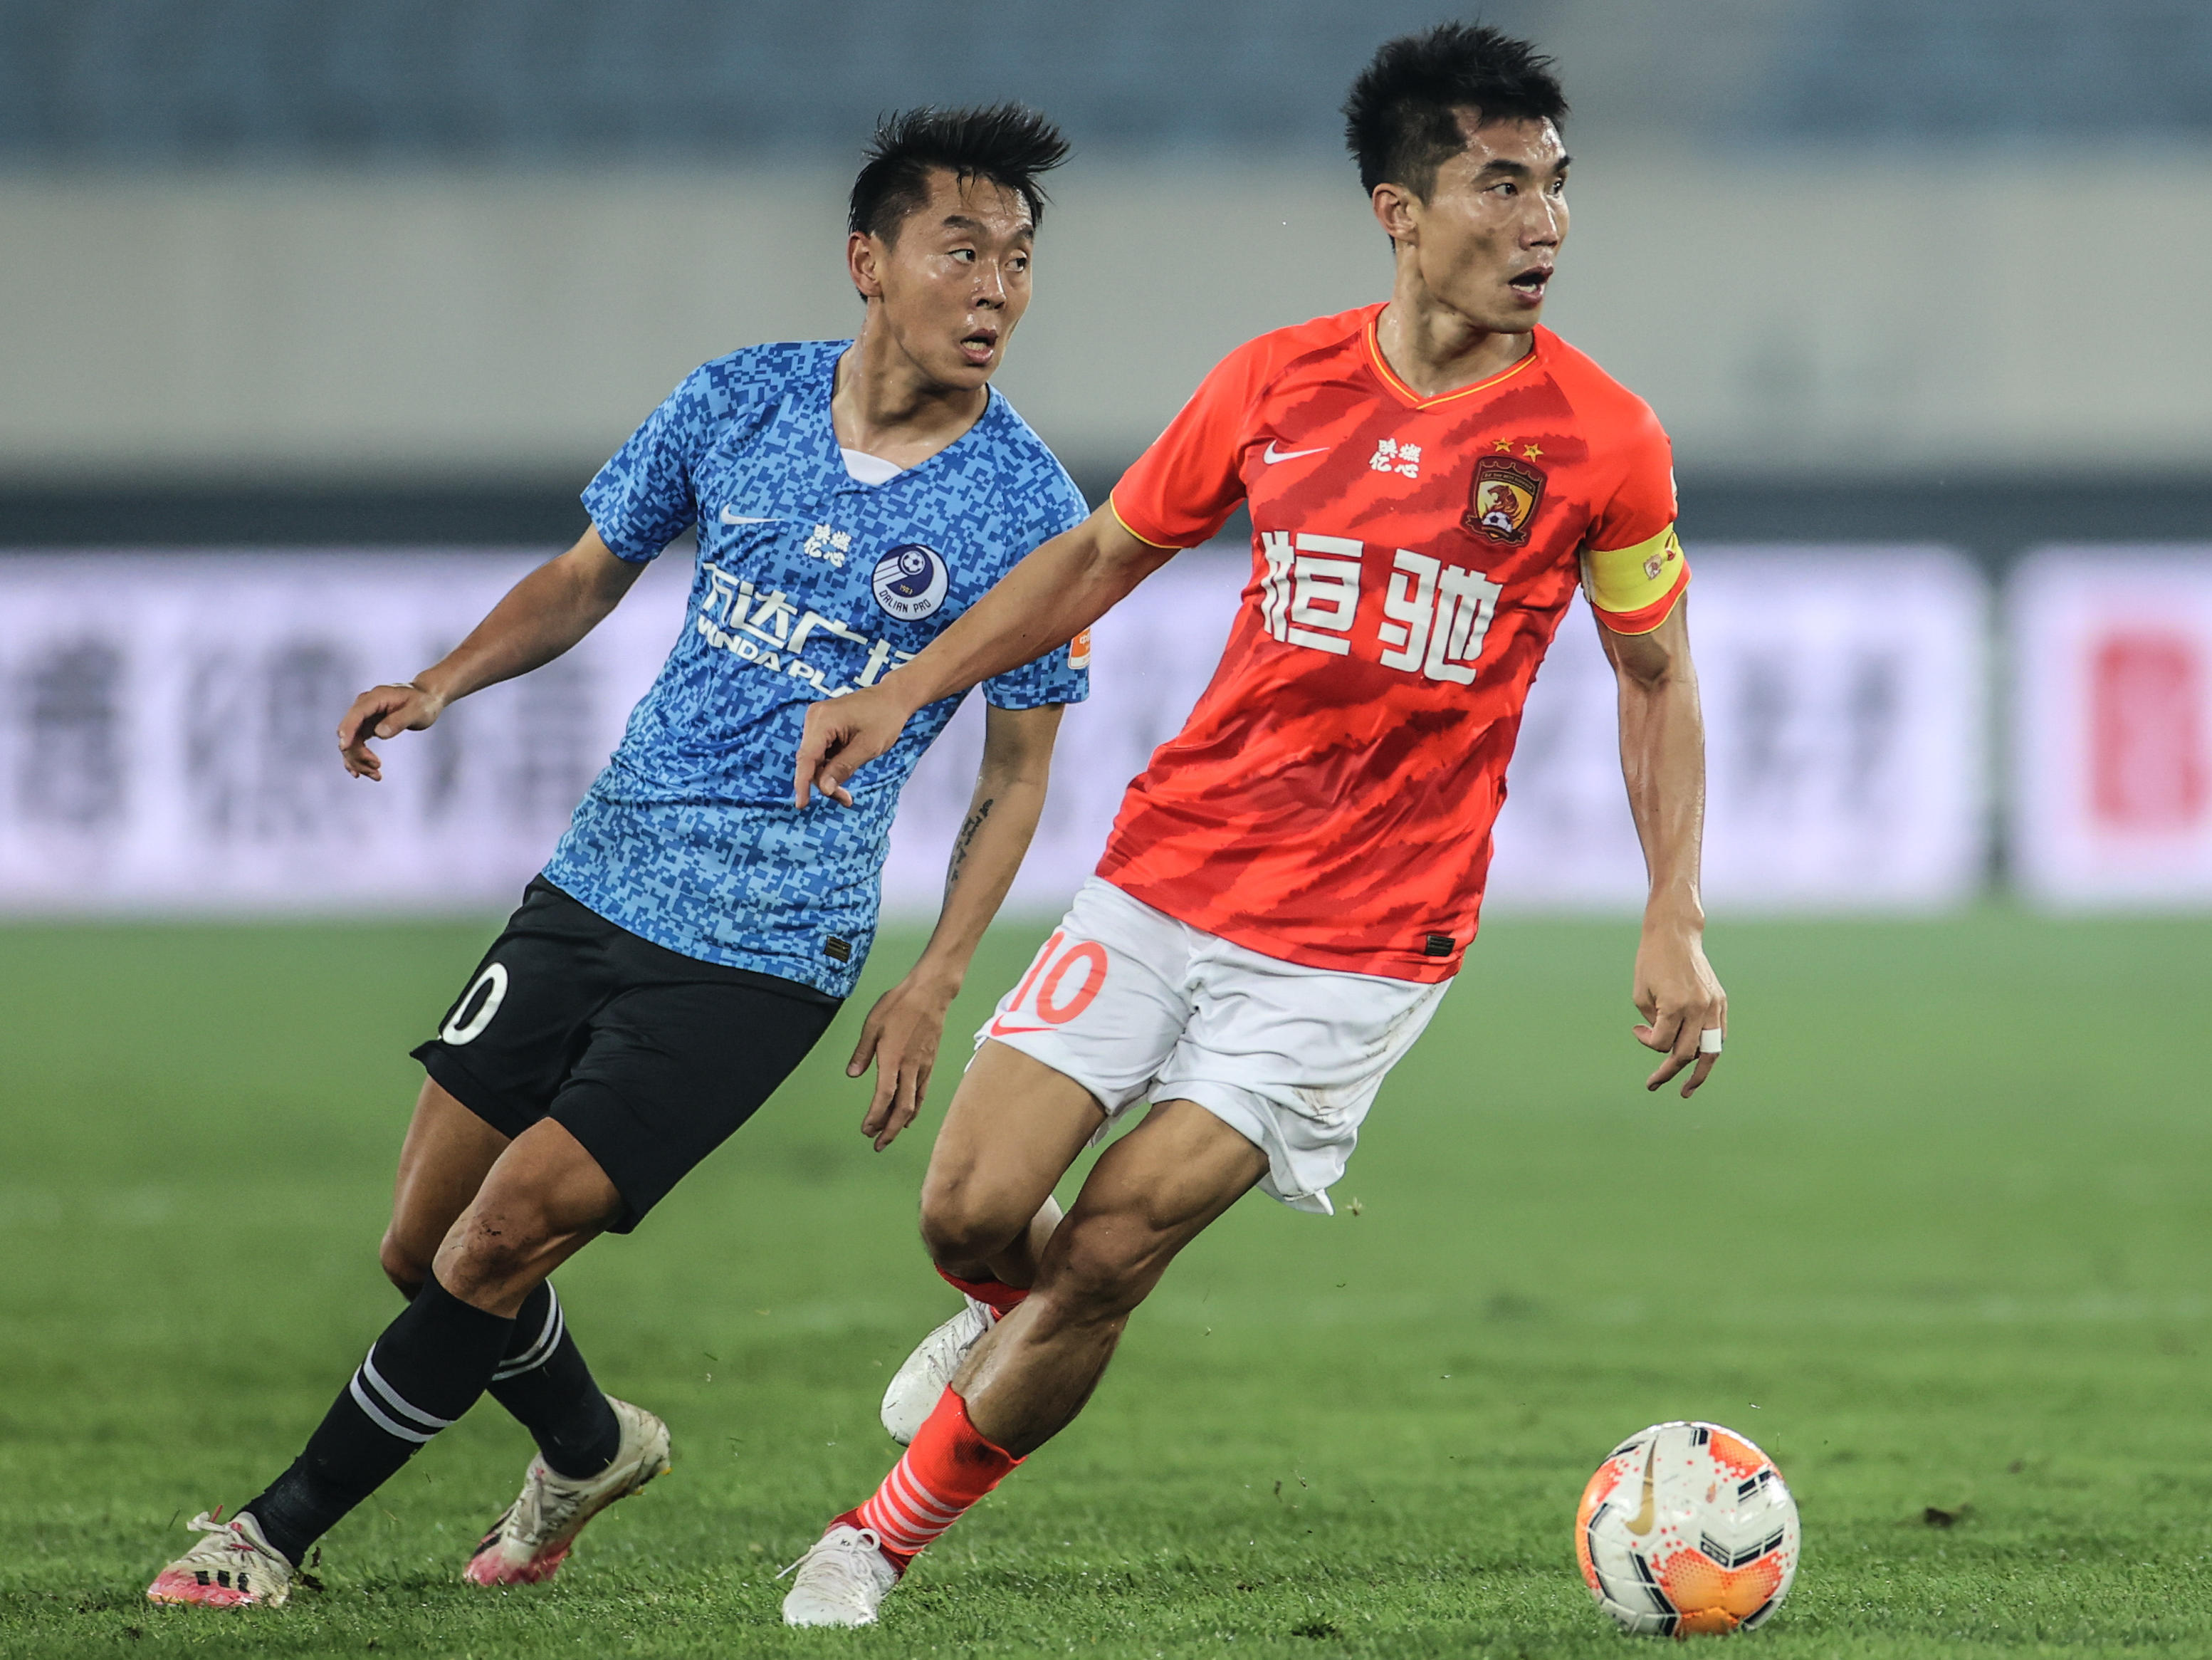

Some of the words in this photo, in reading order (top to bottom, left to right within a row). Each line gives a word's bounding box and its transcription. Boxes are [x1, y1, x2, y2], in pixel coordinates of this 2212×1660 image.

[879, 589, 909, 613] DALIAN
[913, 599, 932, 613] PRO
[1262, 530, 1503, 686] 恒驰
[698, 613, 782, 672] WNDA
[1006, 930, 1108, 1025] 10
